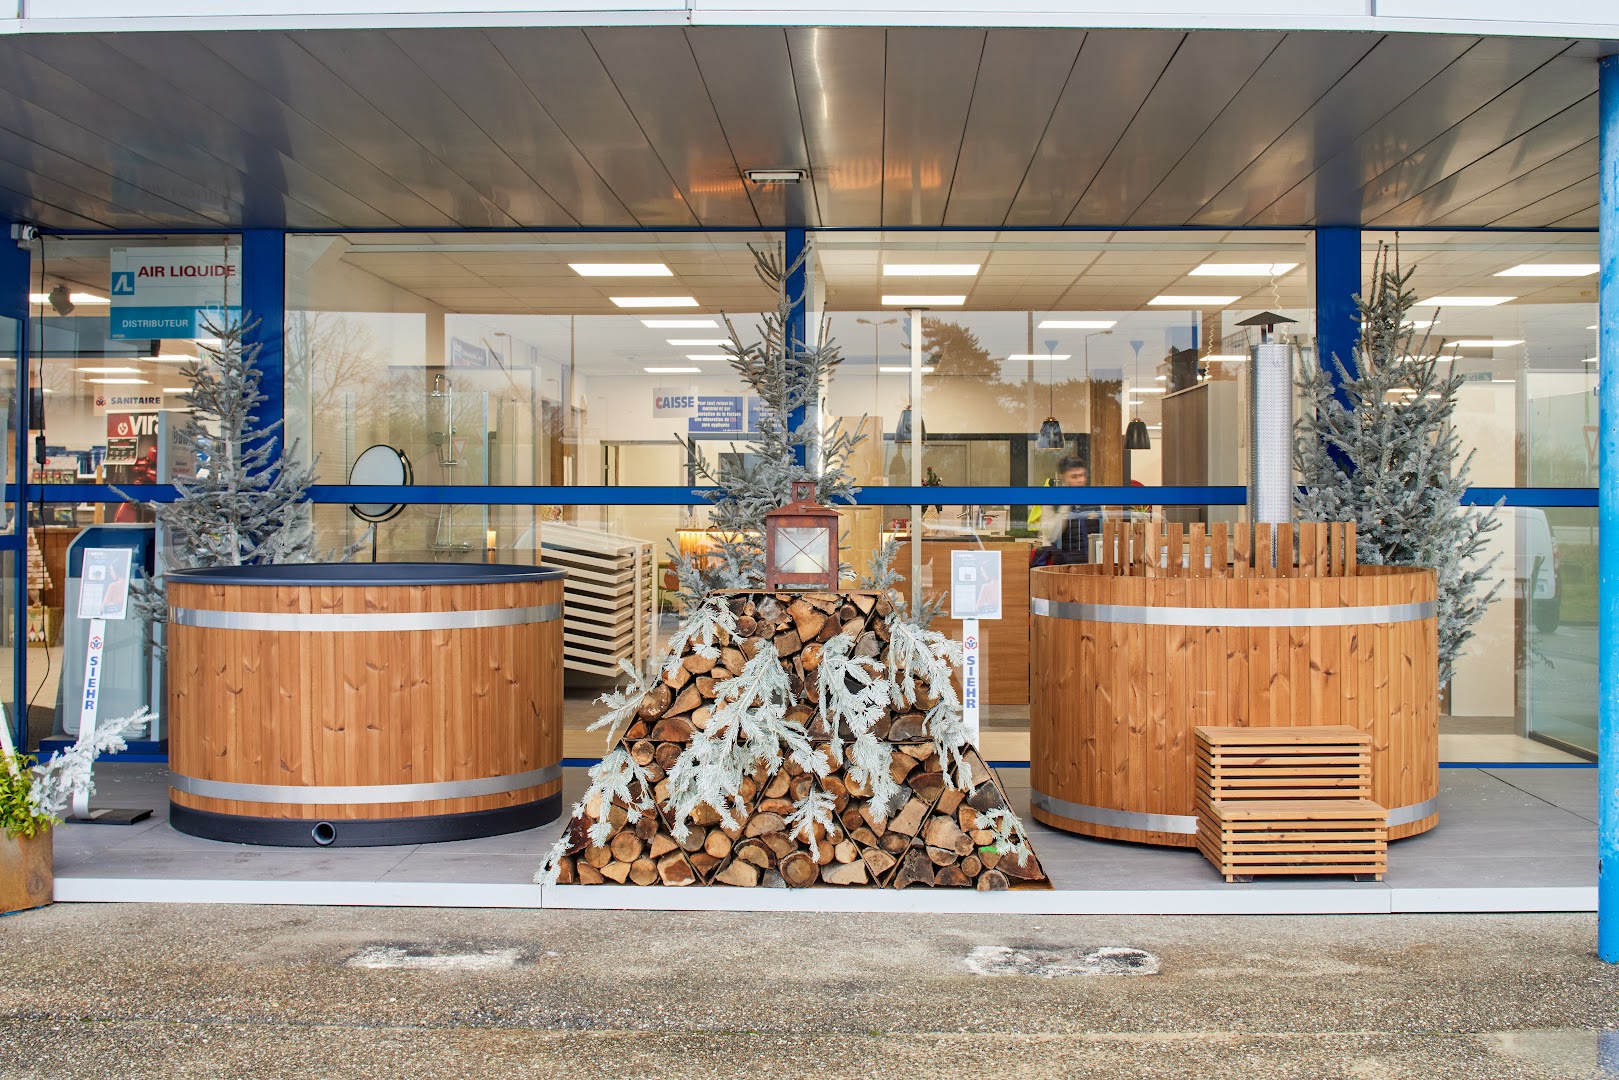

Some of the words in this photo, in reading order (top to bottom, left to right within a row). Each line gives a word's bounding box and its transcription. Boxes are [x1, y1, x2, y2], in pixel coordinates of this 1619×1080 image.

[138, 266, 165, 277] AIR
[170, 265, 236, 277] LIQUIDE
[122, 319, 189, 328] DISTRIBUTEUR
[110, 397, 161, 405] SANITAIRE
[655, 396, 694, 409] CAISSE
[85, 656, 98, 710] SIEHR
[966, 656, 976, 708] SIEHR
